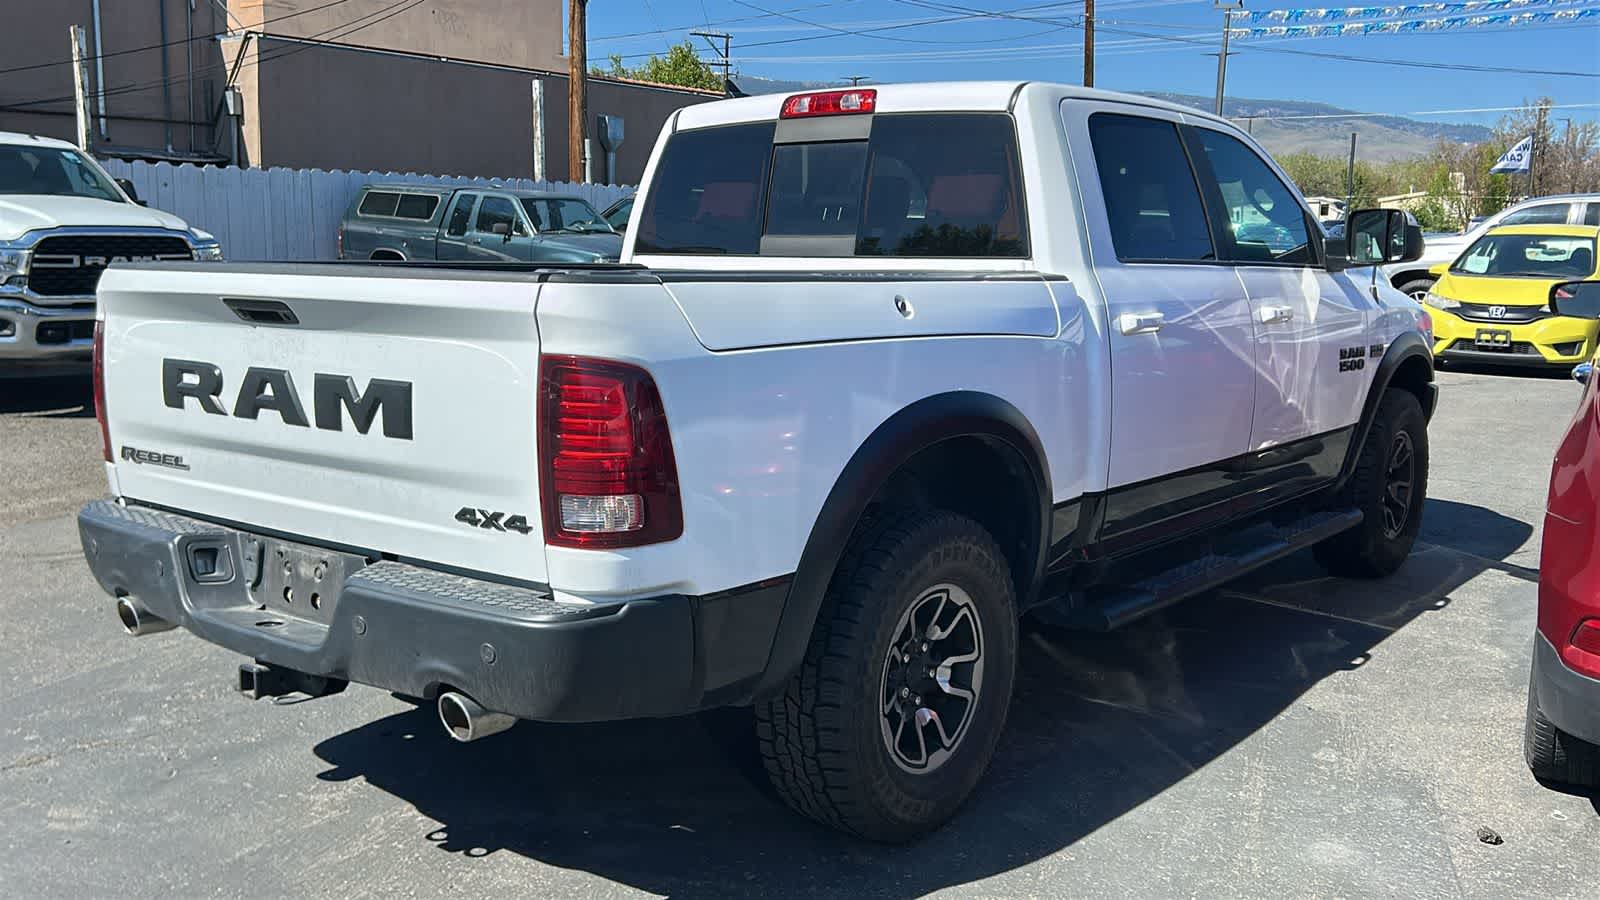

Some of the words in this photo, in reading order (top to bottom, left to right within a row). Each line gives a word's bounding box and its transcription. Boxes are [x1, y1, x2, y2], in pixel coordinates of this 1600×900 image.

[1340, 345, 1366, 360] RAM
[1339, 359, 1365, 373] 1500
[163, 358, 413, 440] RAM
[121, 445, 190, 471] REBEL
[455, 506, 533, 535] 4X4
